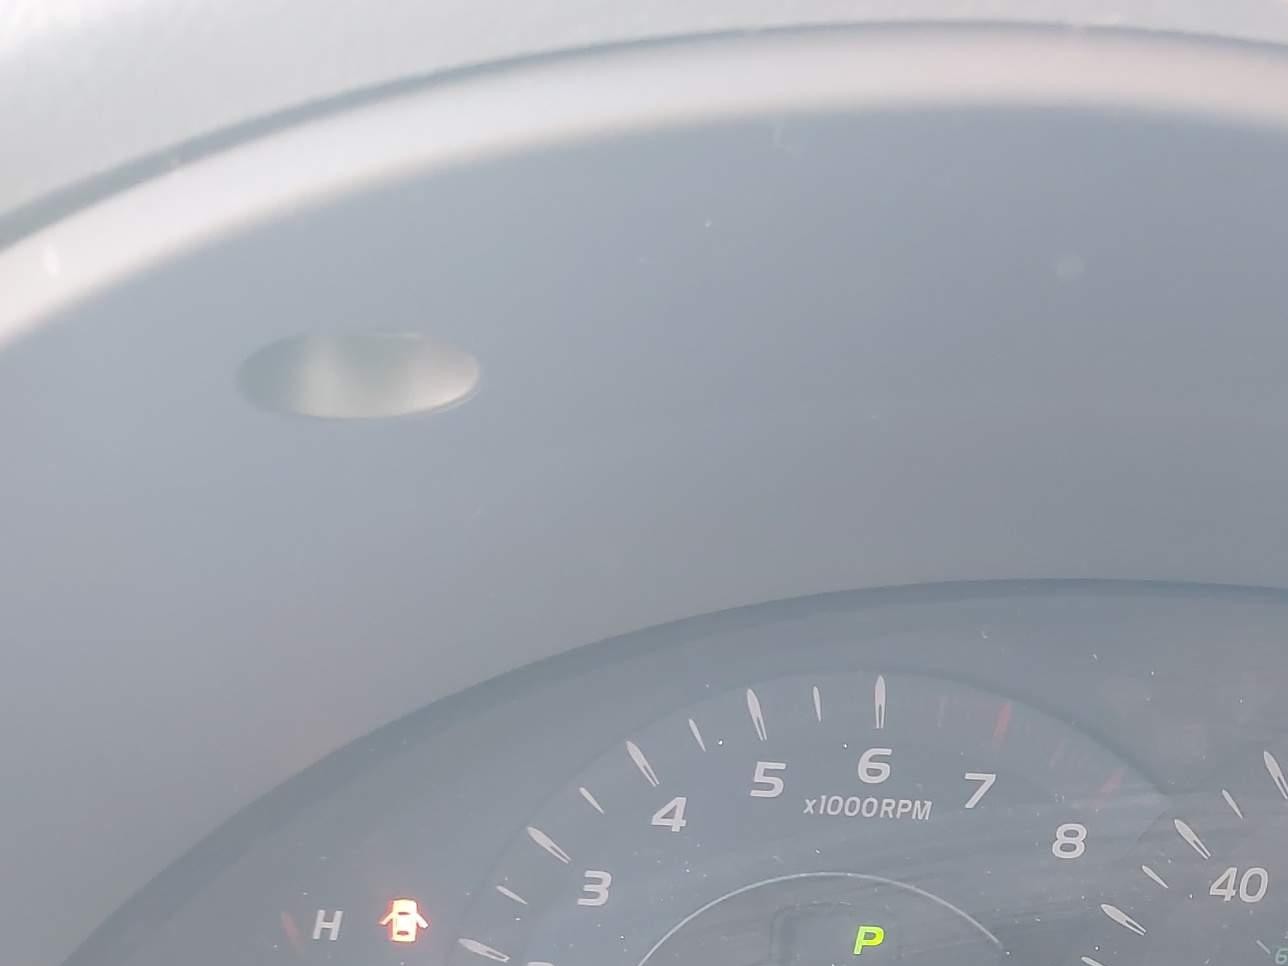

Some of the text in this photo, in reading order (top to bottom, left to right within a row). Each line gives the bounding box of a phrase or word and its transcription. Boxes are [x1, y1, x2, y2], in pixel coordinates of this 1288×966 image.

[750, 761, 787, 798] 5
[857, 748, 892, 784] 6
[963, 772, 997, 809] 7
[651, 796, 688, 832] 4
[1052, 822, 1088, 859] 8
[577, 869, 613, 906] 3
[1209, 866, 1269, 903] 40
[312, 909, 344, 941] H
[853, 926, 885, 955] P
